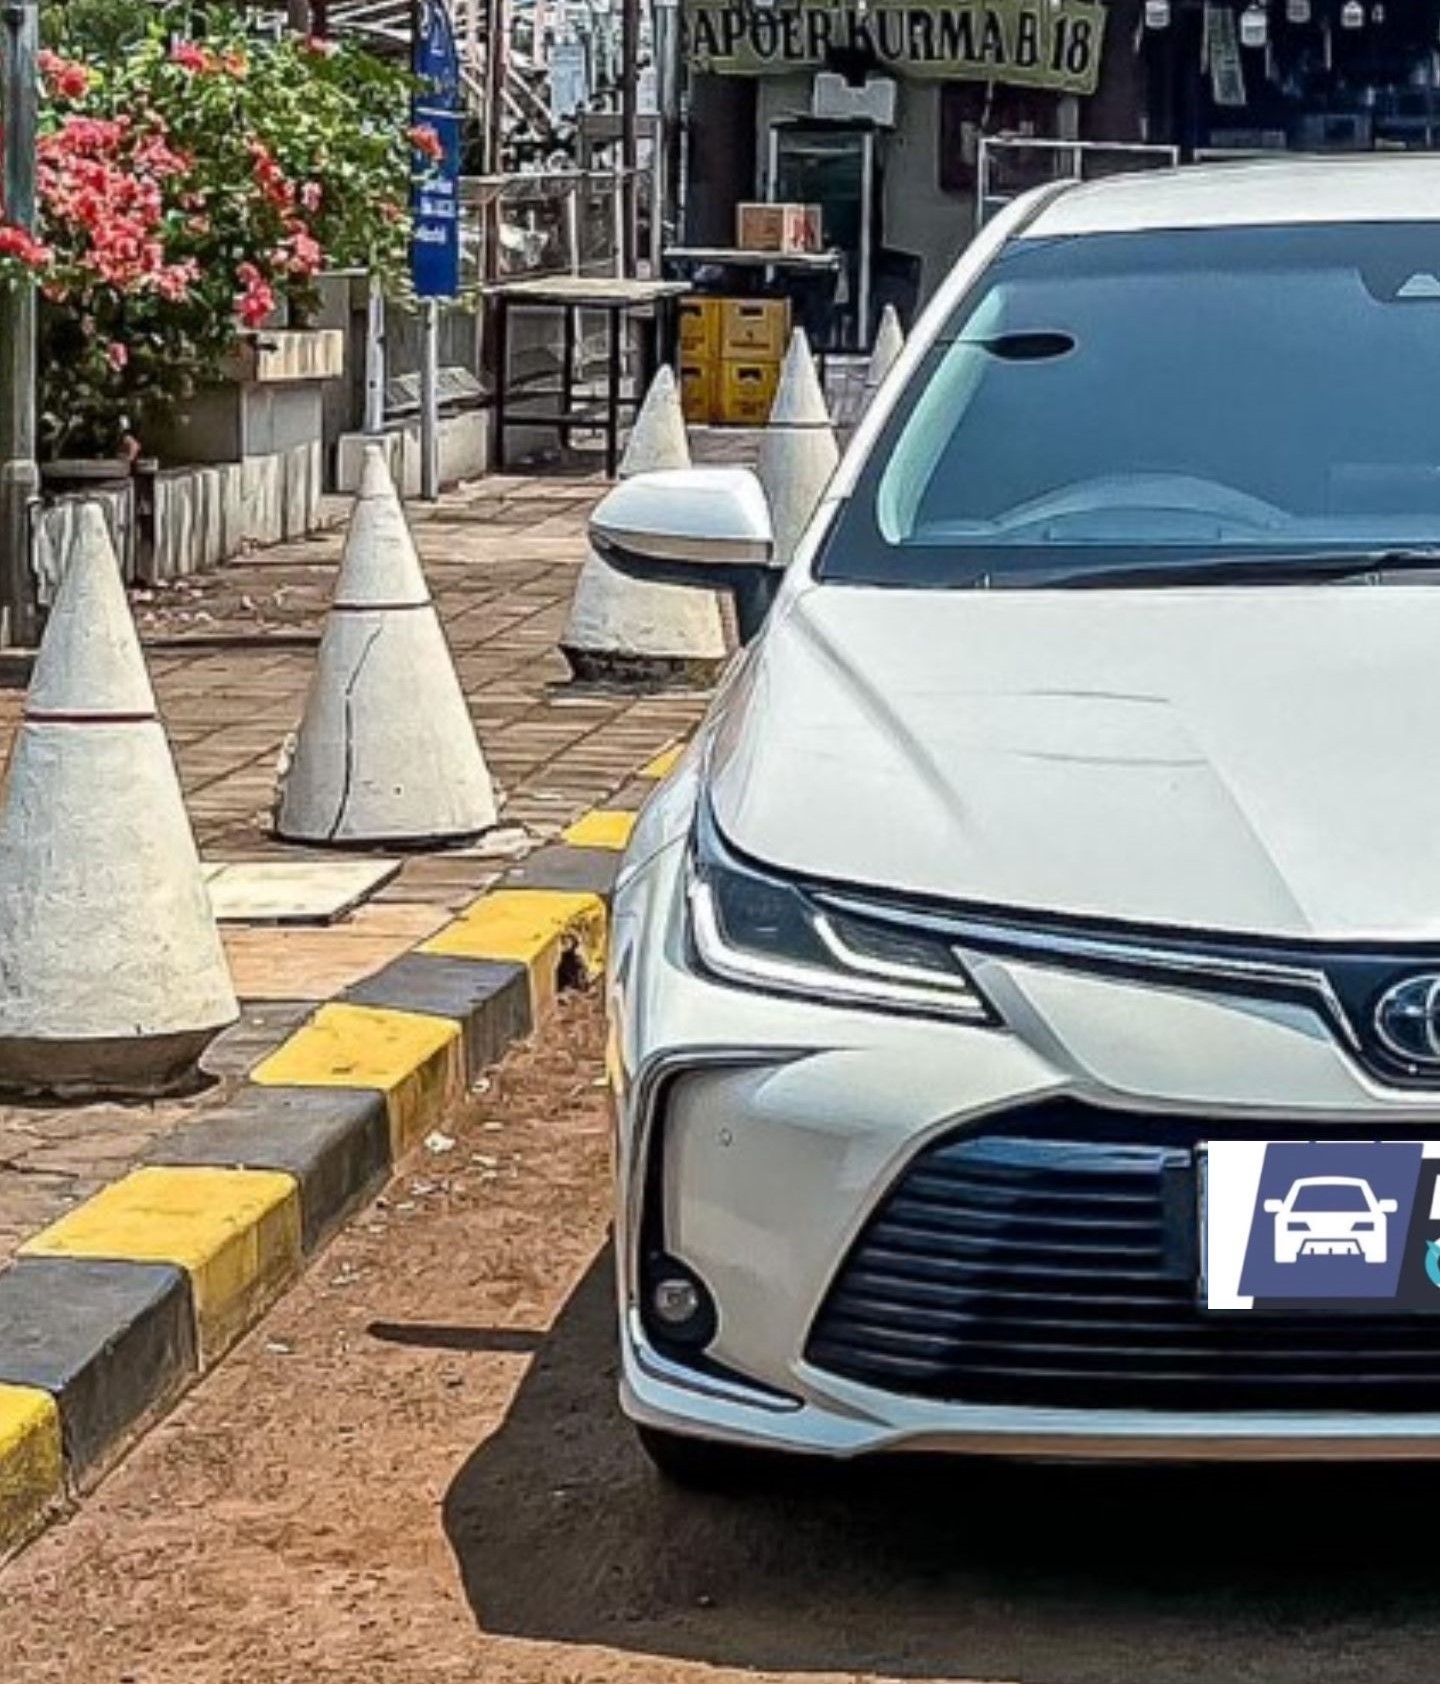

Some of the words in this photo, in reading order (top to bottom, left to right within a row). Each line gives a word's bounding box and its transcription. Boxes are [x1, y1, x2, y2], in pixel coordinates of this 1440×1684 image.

[681, 8, 831, 58] APOER
[847, 8, 1005, 63] KURMA
[1051, 18, 1091, 75] 18
